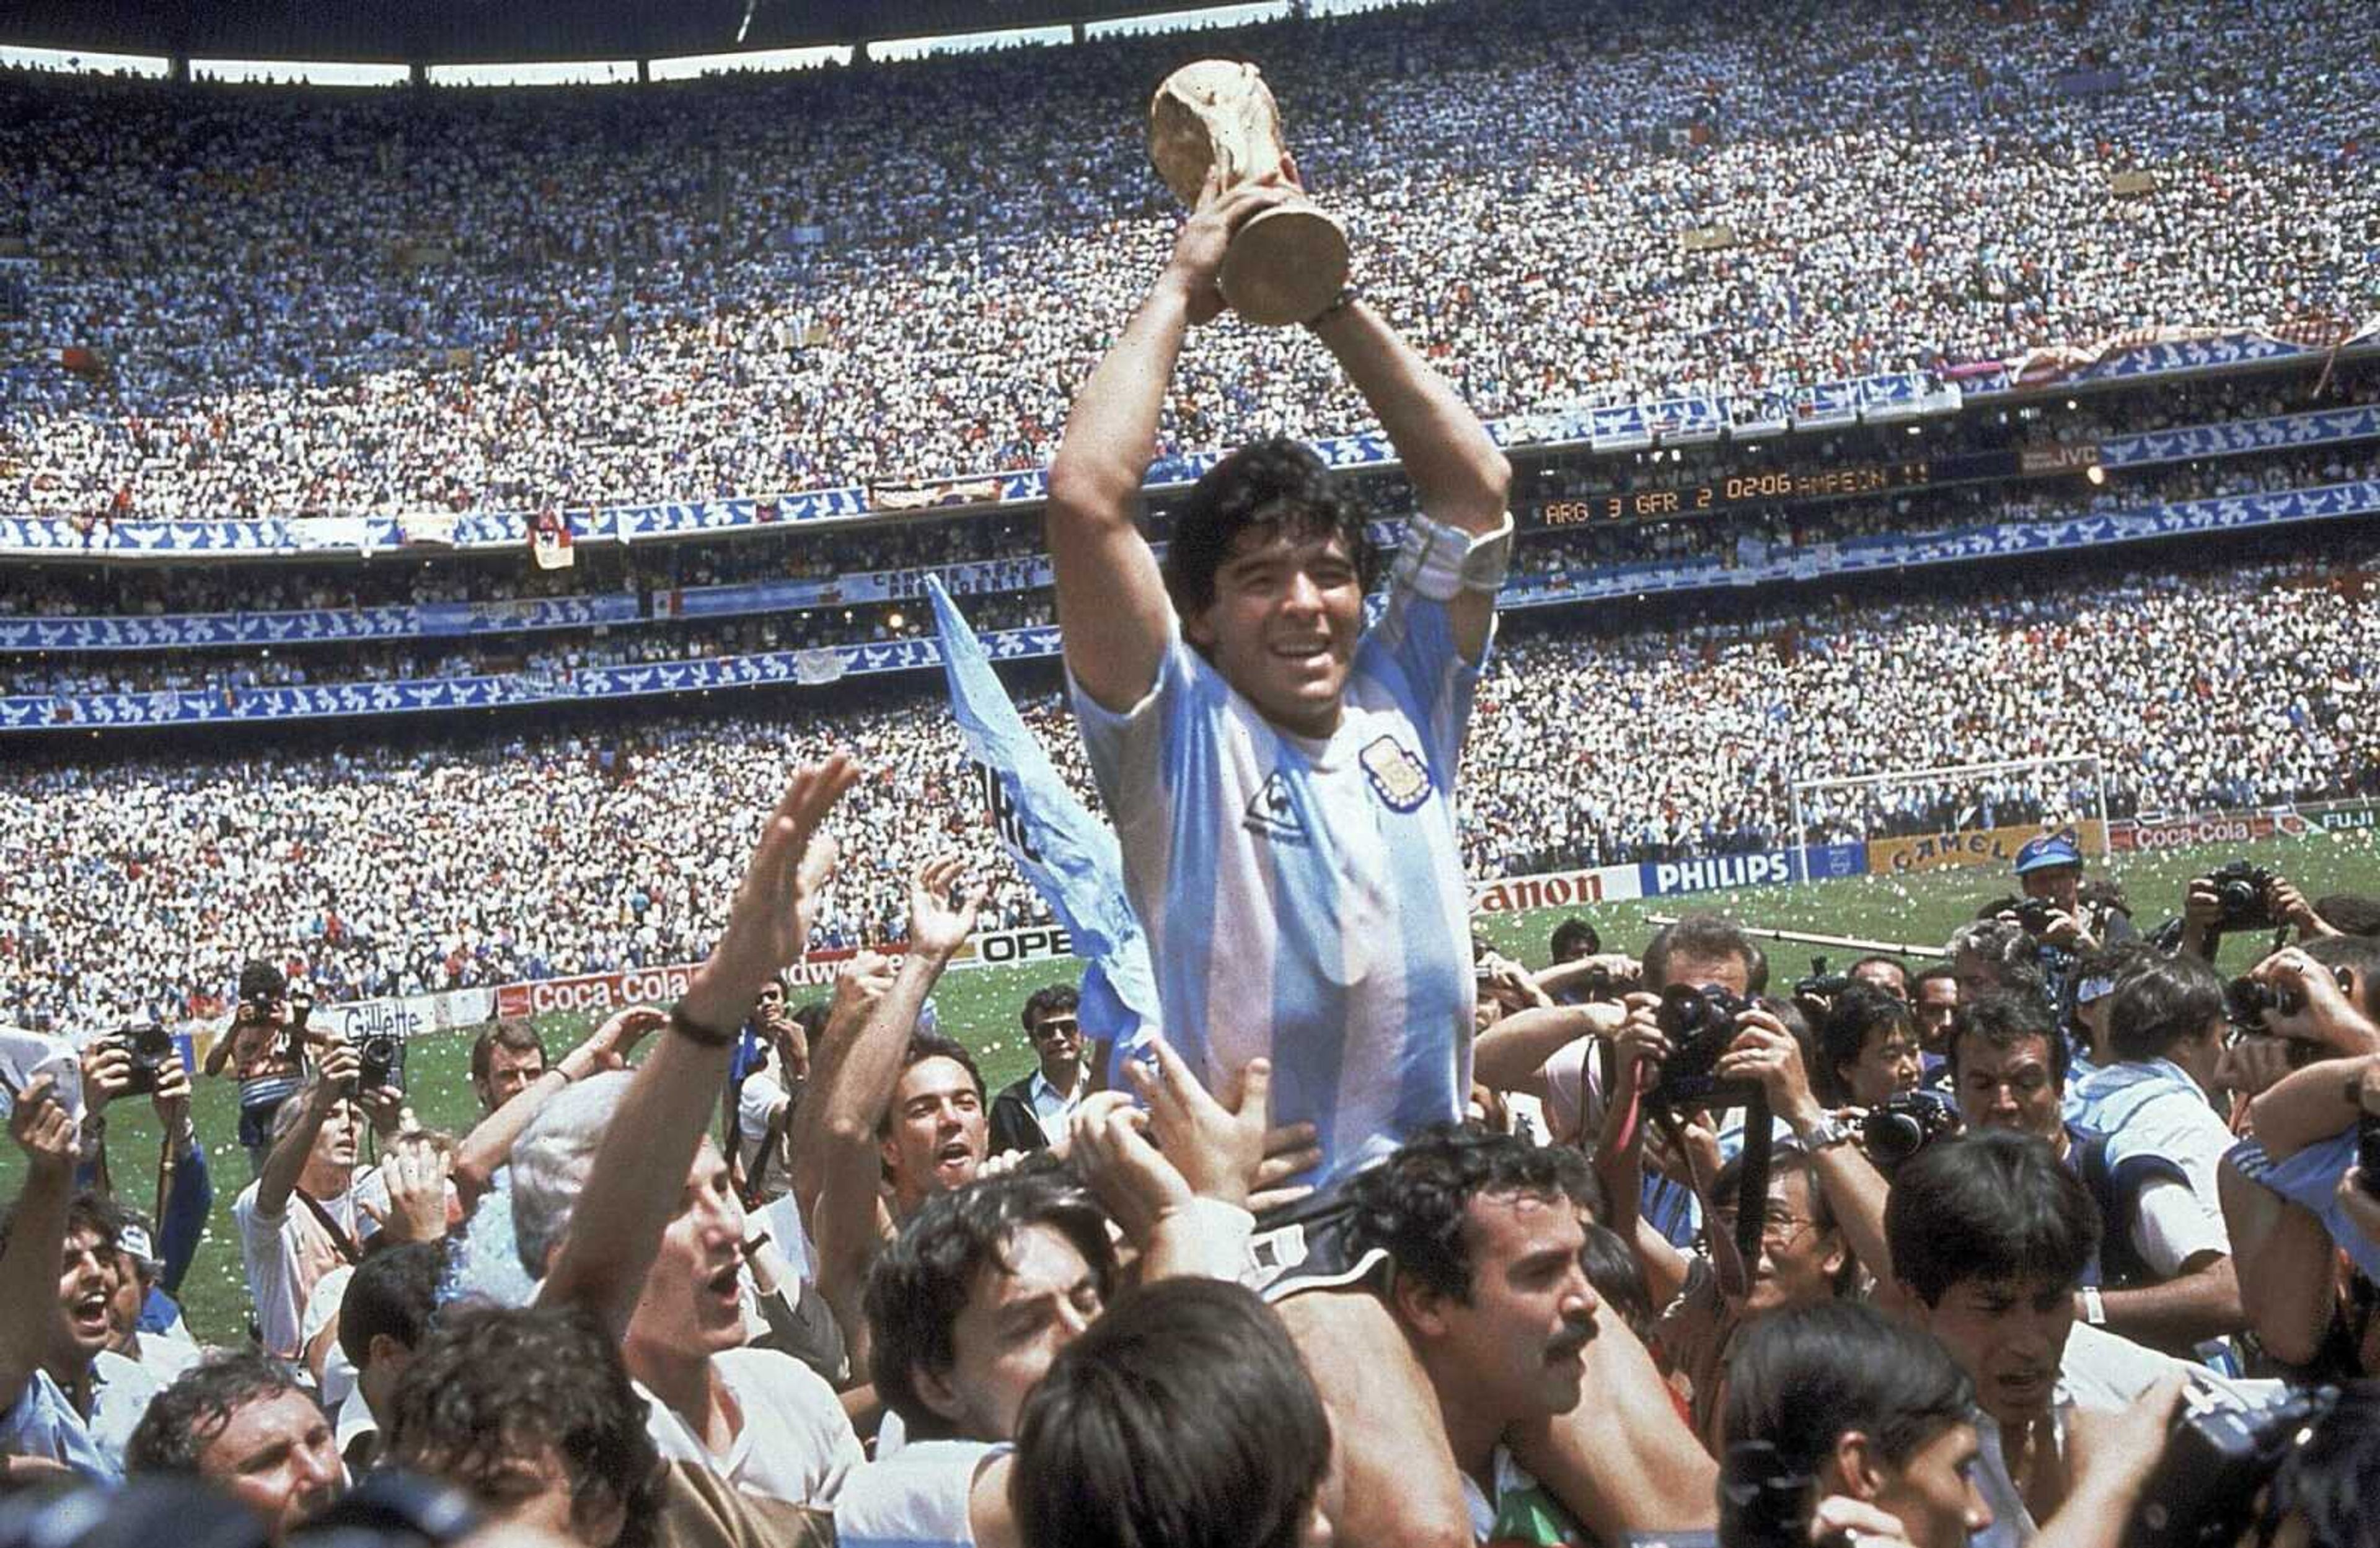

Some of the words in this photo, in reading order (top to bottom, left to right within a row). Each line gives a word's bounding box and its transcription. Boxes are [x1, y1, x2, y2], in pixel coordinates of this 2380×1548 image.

[2053, 445, 2098, 467] JVC
[1546, 503, 1588, 525] ARG
[1609, 499, 1621, 517] 3
[1697, 488, 1712, 508] 2
[2323, 811, 2374, 828] FUJI
[1892, 834, 2009, 869] CAMEL
[1656, 853, 1789, 893] PHILIPS
[982, 933, 1071, 962] OPE
[346, 1000, 423, 1040] Gillette
